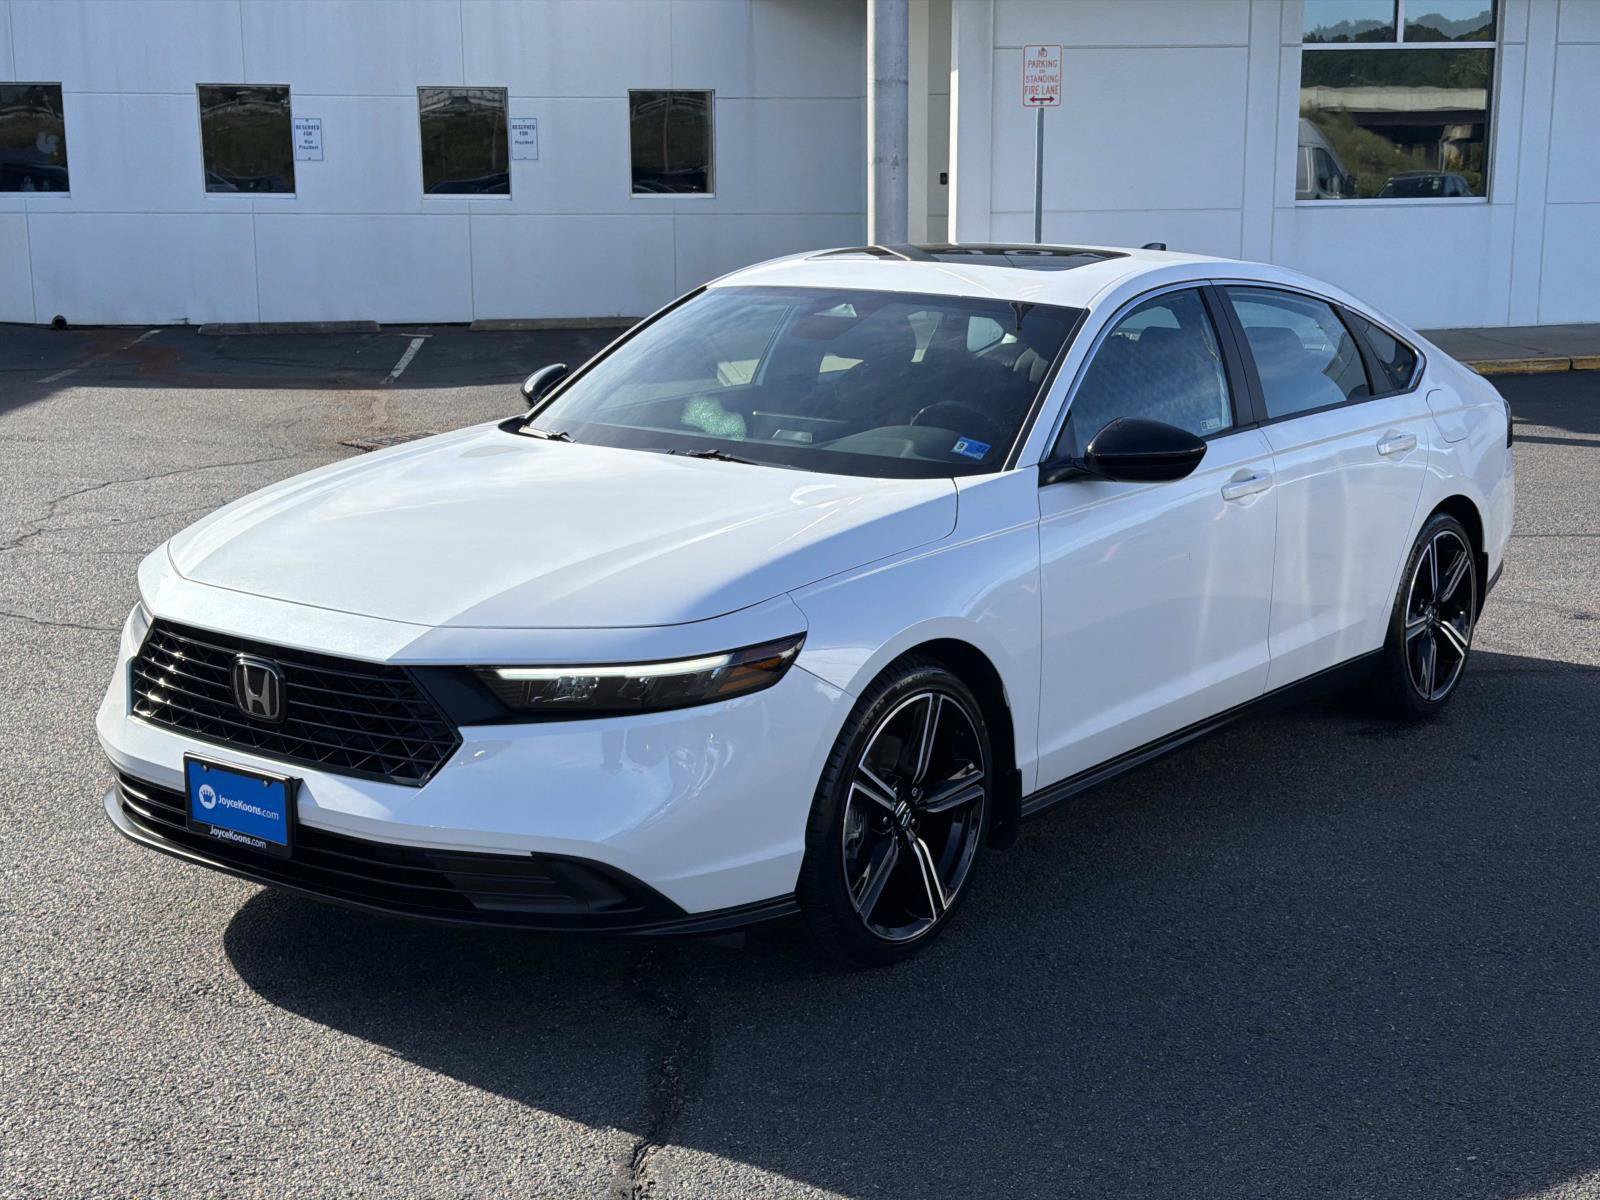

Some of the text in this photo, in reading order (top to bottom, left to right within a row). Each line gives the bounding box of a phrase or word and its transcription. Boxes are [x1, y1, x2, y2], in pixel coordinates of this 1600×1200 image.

[1037, 50, 1048, 58] NO
[1027, 60, 1058, 68] PARKING
[1025, 75, 1059, 84] STANDING
[1024, 85, 1059, 95] FIRE LANE
[218, 794, 280, 820] JoyceKoons.com
[209, 825, 267, 849] JoyceKoons.com
